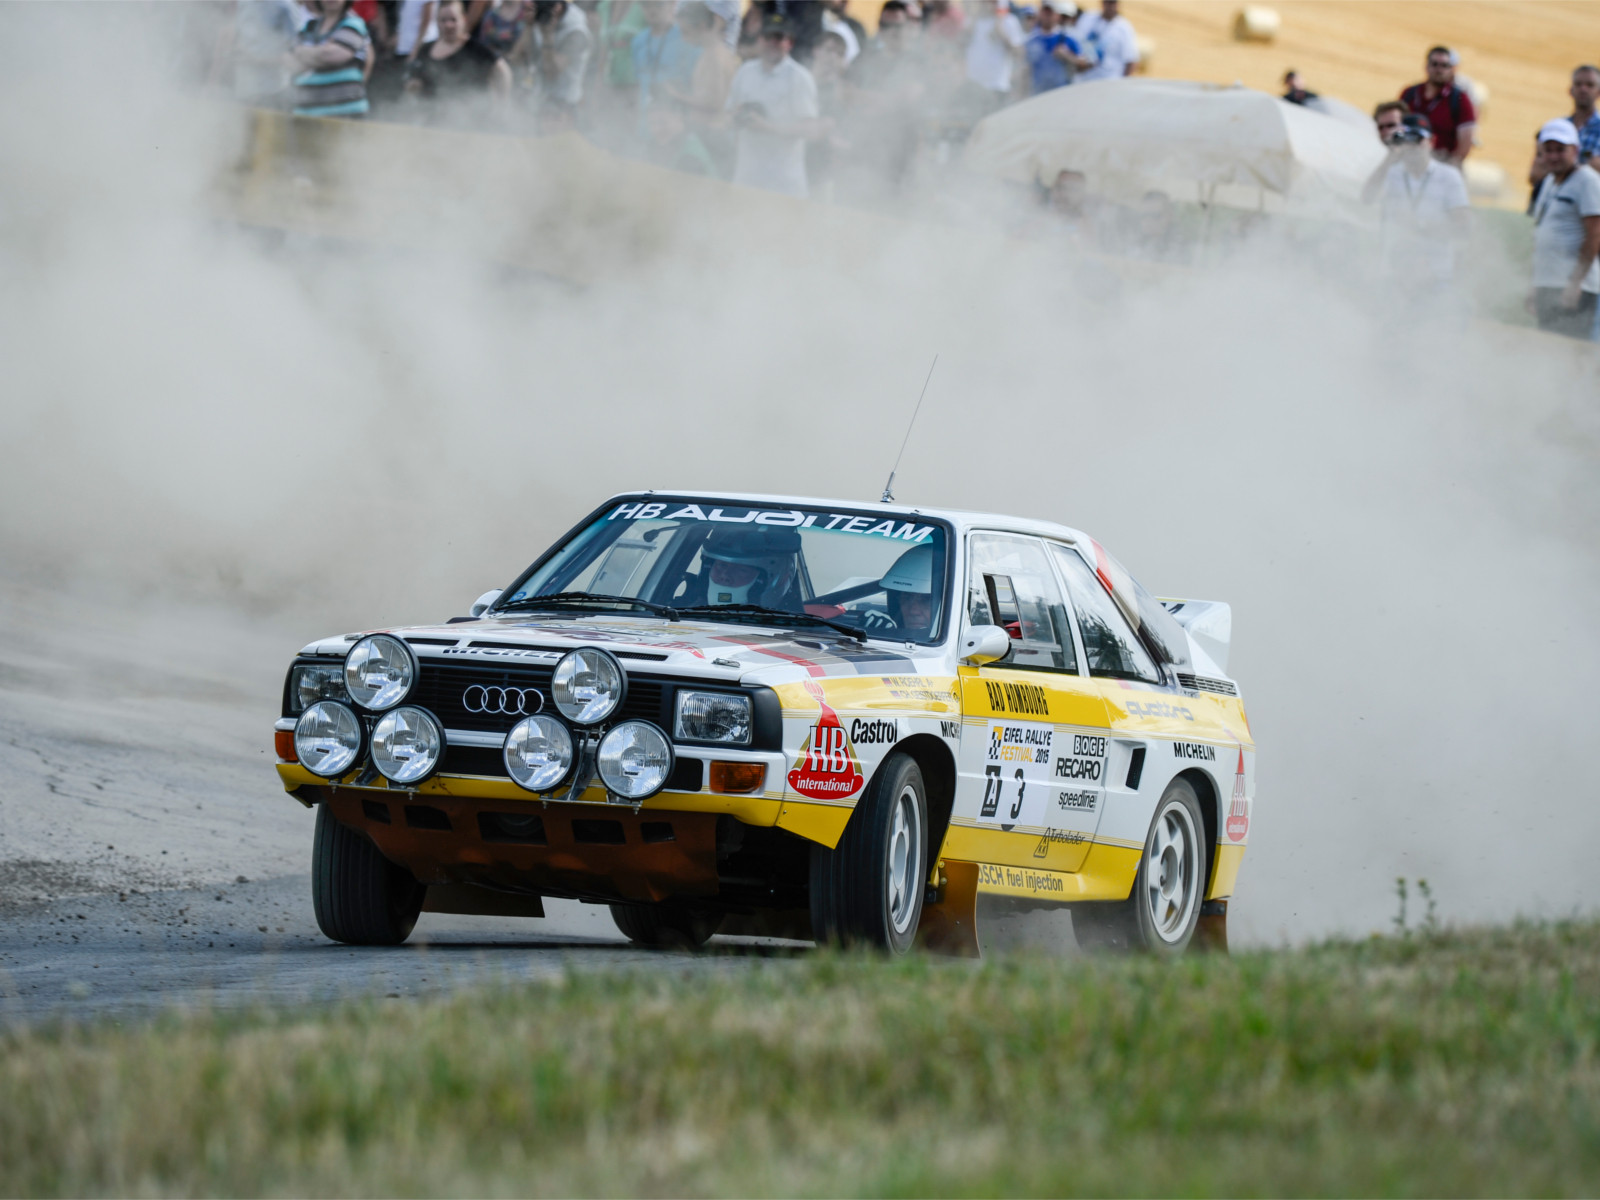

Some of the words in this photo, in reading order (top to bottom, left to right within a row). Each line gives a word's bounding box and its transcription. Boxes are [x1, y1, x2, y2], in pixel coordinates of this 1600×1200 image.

[607, 502, 667, 520] HB
[823, 513, 935, 542] TEAM
[442, 646, 564, 660] MICHEL
[986, 681, 1005, 712] BAD
[1003, 683, 1049, 716] HOMBOURG
[851, 718, 898, 744] Castrol
[1003, 727, 1024, 745] EIFEL
[1025, 730, 1053, 748] RALLYE
[809, 725, 849, 774] HB
[1000, 746, 1034, 763] FESTIVAL
[1035, 749, 1050, 765] 2015
[1074, 735, 1105, 757] BOGE
[1173, 742, 1216, 761] MICHELIN
[1055, 757, 1101, 781] RECARO
[796, 777, 855, 793] international
[1010, 768, 1026, 820] 3
[1058, 790, 1095, 810] speedline
[978, 864, 1005, 886] OSCH
[1006, 868, 1024, 888] fuel
[1025, 870, 1064, 893] injection
